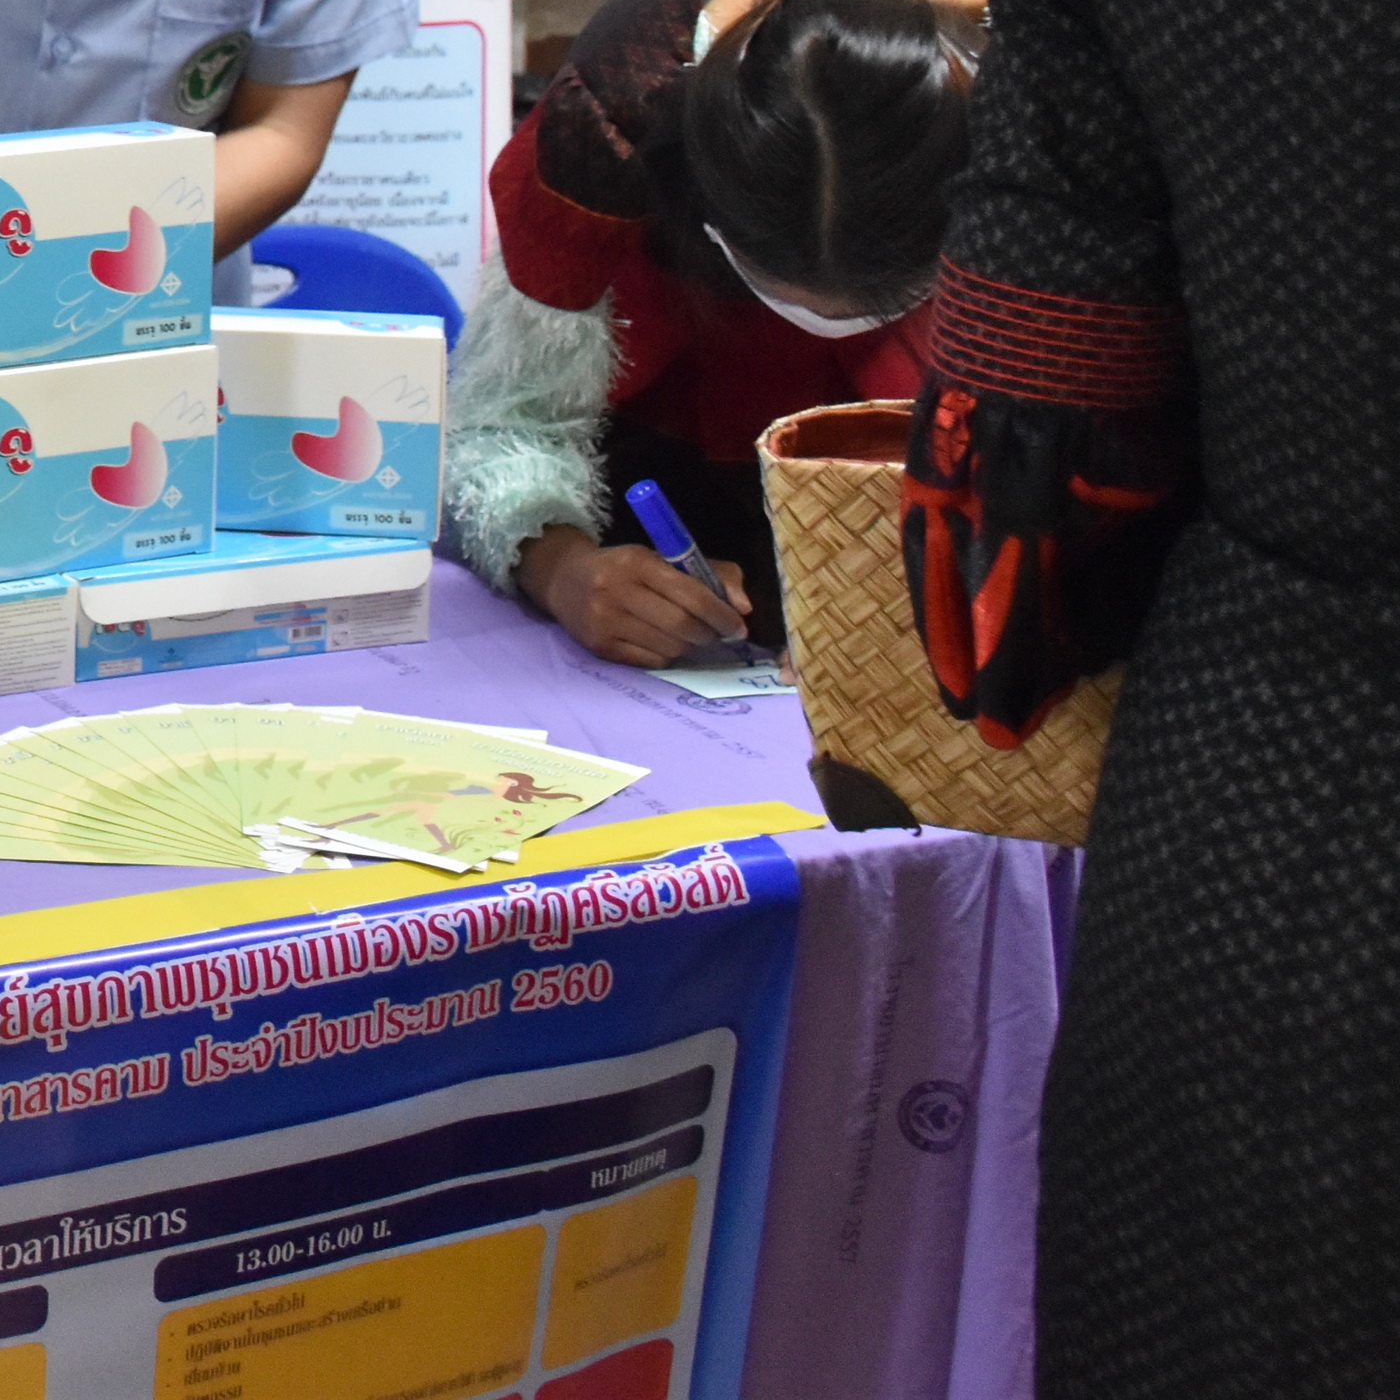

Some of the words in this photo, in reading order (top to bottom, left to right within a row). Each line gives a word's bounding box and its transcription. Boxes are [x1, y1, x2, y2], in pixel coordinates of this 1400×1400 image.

[183, 980, 501, 1087] ประจำปีงบประมาณ
[511, 962, 612, 1011] 2560
[235, 1225, 364, 1273] 13.00-16.00
[371, 1218, 392, 1240] น.
